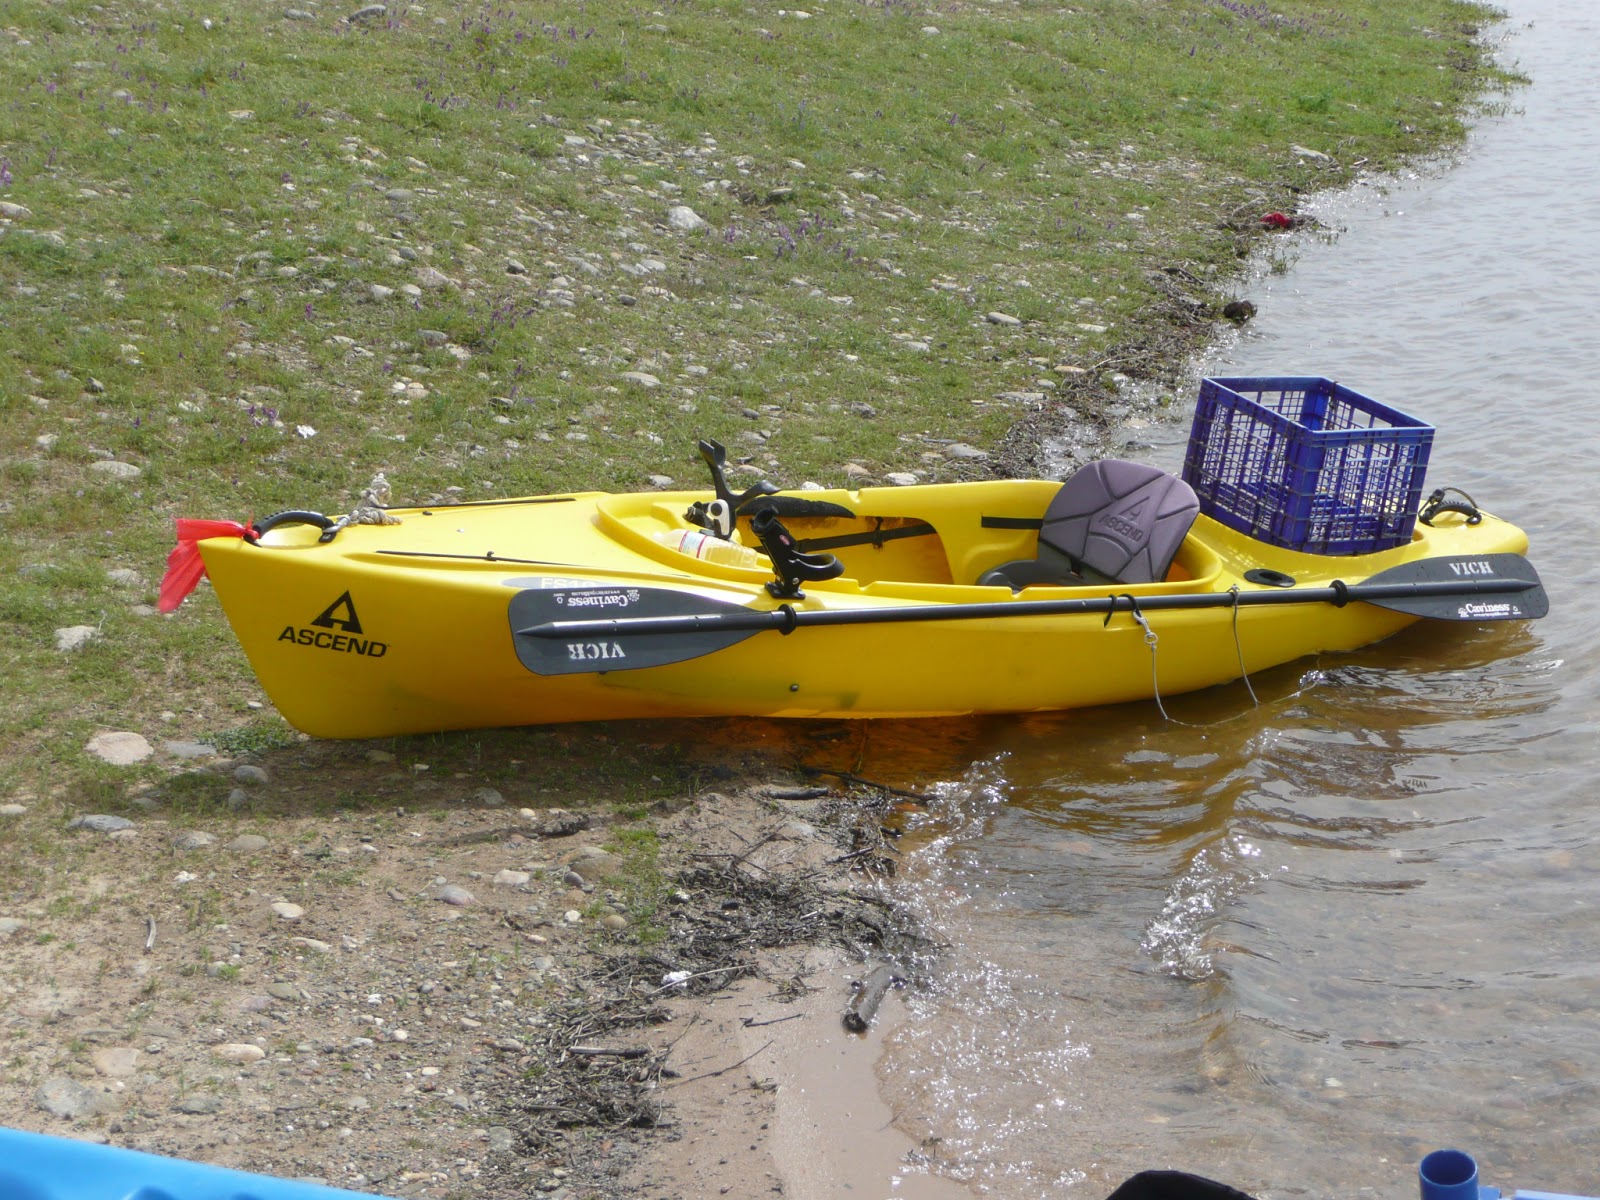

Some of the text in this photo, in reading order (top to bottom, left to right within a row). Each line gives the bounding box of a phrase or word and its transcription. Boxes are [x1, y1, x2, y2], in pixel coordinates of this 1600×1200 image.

[1099, 514, 1144, 542] ASCEND
[1449, 561, 1493, 575] VICH
[567, 594, 629, 608] Caviness
[1465, 602, 1511, 614] Caviness
[278, 626, 388, 658] ASCEND
